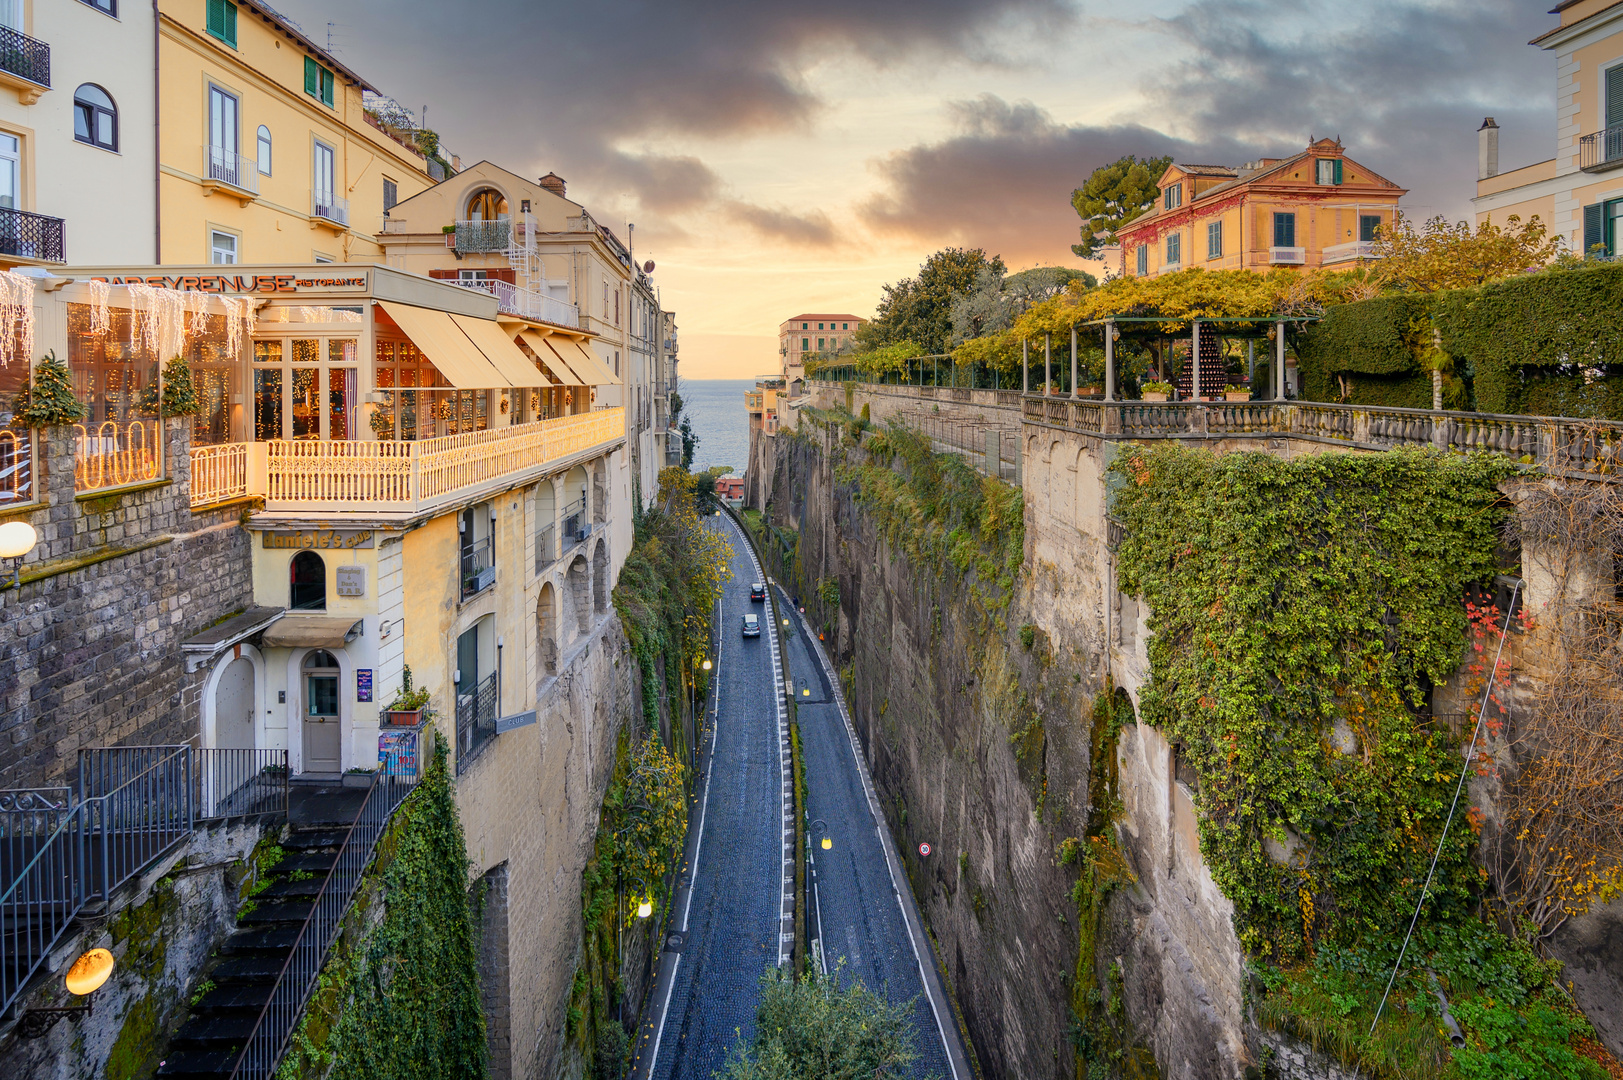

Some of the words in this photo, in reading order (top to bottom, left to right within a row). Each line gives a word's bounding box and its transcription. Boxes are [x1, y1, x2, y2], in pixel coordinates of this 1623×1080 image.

[263, 530, 342, 548] daniele's
[345, 530, 371, 548] CLUB
[508, 715, 525, 726] CLUB
